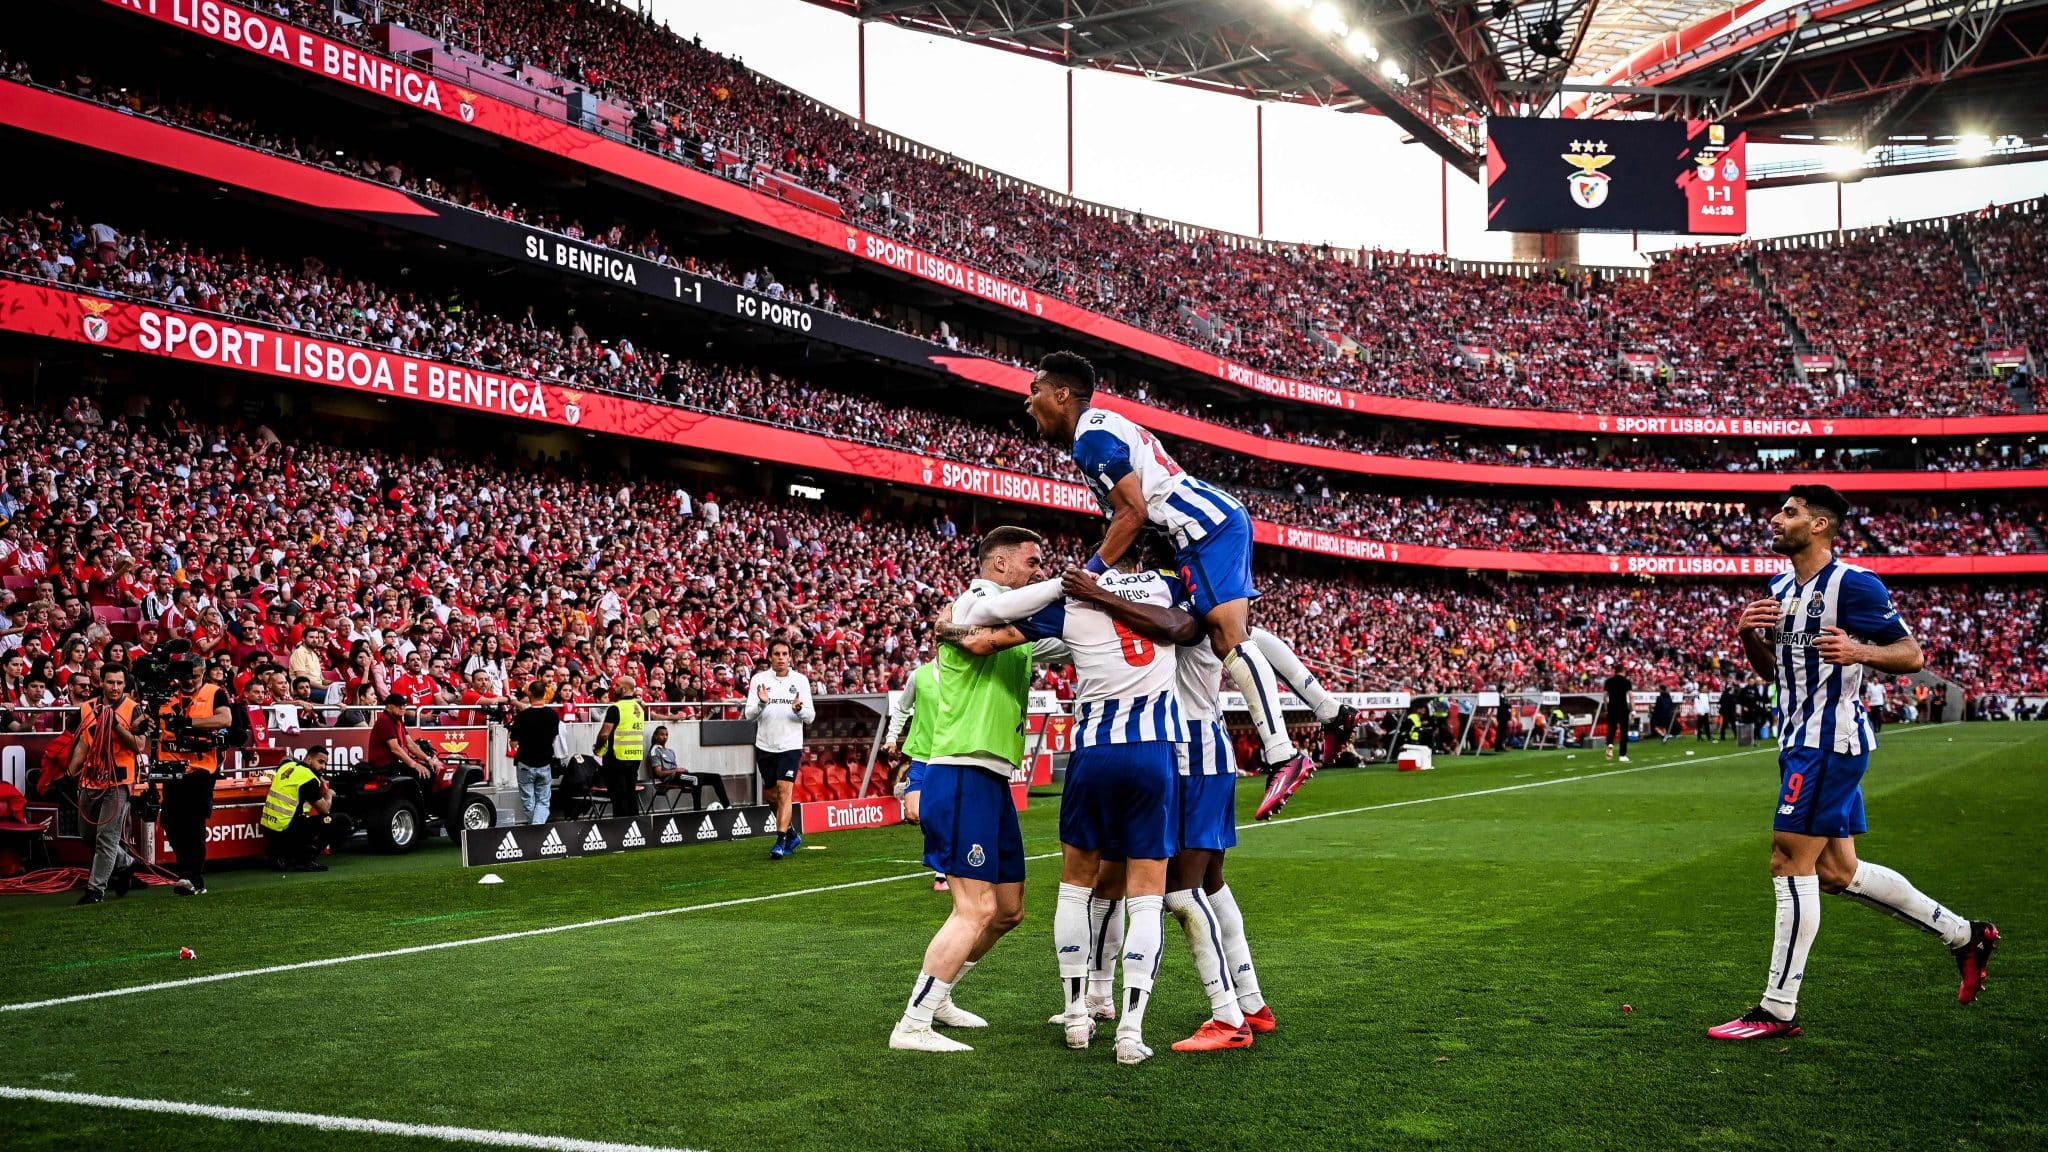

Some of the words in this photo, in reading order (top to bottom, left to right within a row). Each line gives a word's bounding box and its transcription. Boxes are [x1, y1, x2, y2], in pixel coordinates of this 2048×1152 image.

[173, 0, 290, 60] LISBOA
[299, 34, 314, 67] E
[324, 43, 442, 111] BENFICA
[1706, 185, 1731, 202] 1-1
[866, 236, 914, 271] SPORT
[916, 253, 965, 289] LISBOA
[967, 271, 975, 292] E
[977, 275, 1029, 311] BENFICA
[526, 235, 549, 262] SL
[556, 243, 637, 285] BENFICA
[674, 276, 701, 303] 1-1
[736, 294, 757, 317] FC
[761, 301, 812, 332] PORTO
[139, 311, 265, 367] SPORT
[275, 337, 395, 391] LISBOA
[403, 361, 419, 395] E
[428, 366, 548, 418] BENFICA
[1228, 363, 1254, 386] SPORT
[1254, 372, 1287, 396] LISBOA
[1288, 381, 1296, 397] E
[1297, 383, 1343, 406] BENFICA
[1616, 418, 1668, 433] SPORT
[1671, 418, 1728, 434] LISBOA
[1730, 419, 1739, 434] E
[1743, 420, 1812, 435] BENFICA
[942, 463, 991, 494] SPORT
[992, 472, 1041, 502] LISBOA
[1043, 482, 1051, 504] E
[1287, 528, 1313, 549] SPORT
[1345, 540, 1386, 559] BENFICA
[1627, 557, 1676, 573] SPORT
[1679, 558, 1738, 574] LISBOA
[1741, 559, 1750, 574] E
[1754, 559, 1794, 574] BENF
[1785, 773, 1803, 803] 9
[827, 804, 884, 828] Emirates
[205, 823, 264, 843] OSPITAL
[660, 833, 683, 844] adidas
[696, 829, 718, 840] adidas
[731, 826, 752, 836] adidas
[540, 844, 567, 856] adidas
[583, 840, 607, 851] adidas
[622, 836, 646, 847] adidas
[496, 848, 523, 860] adidas
